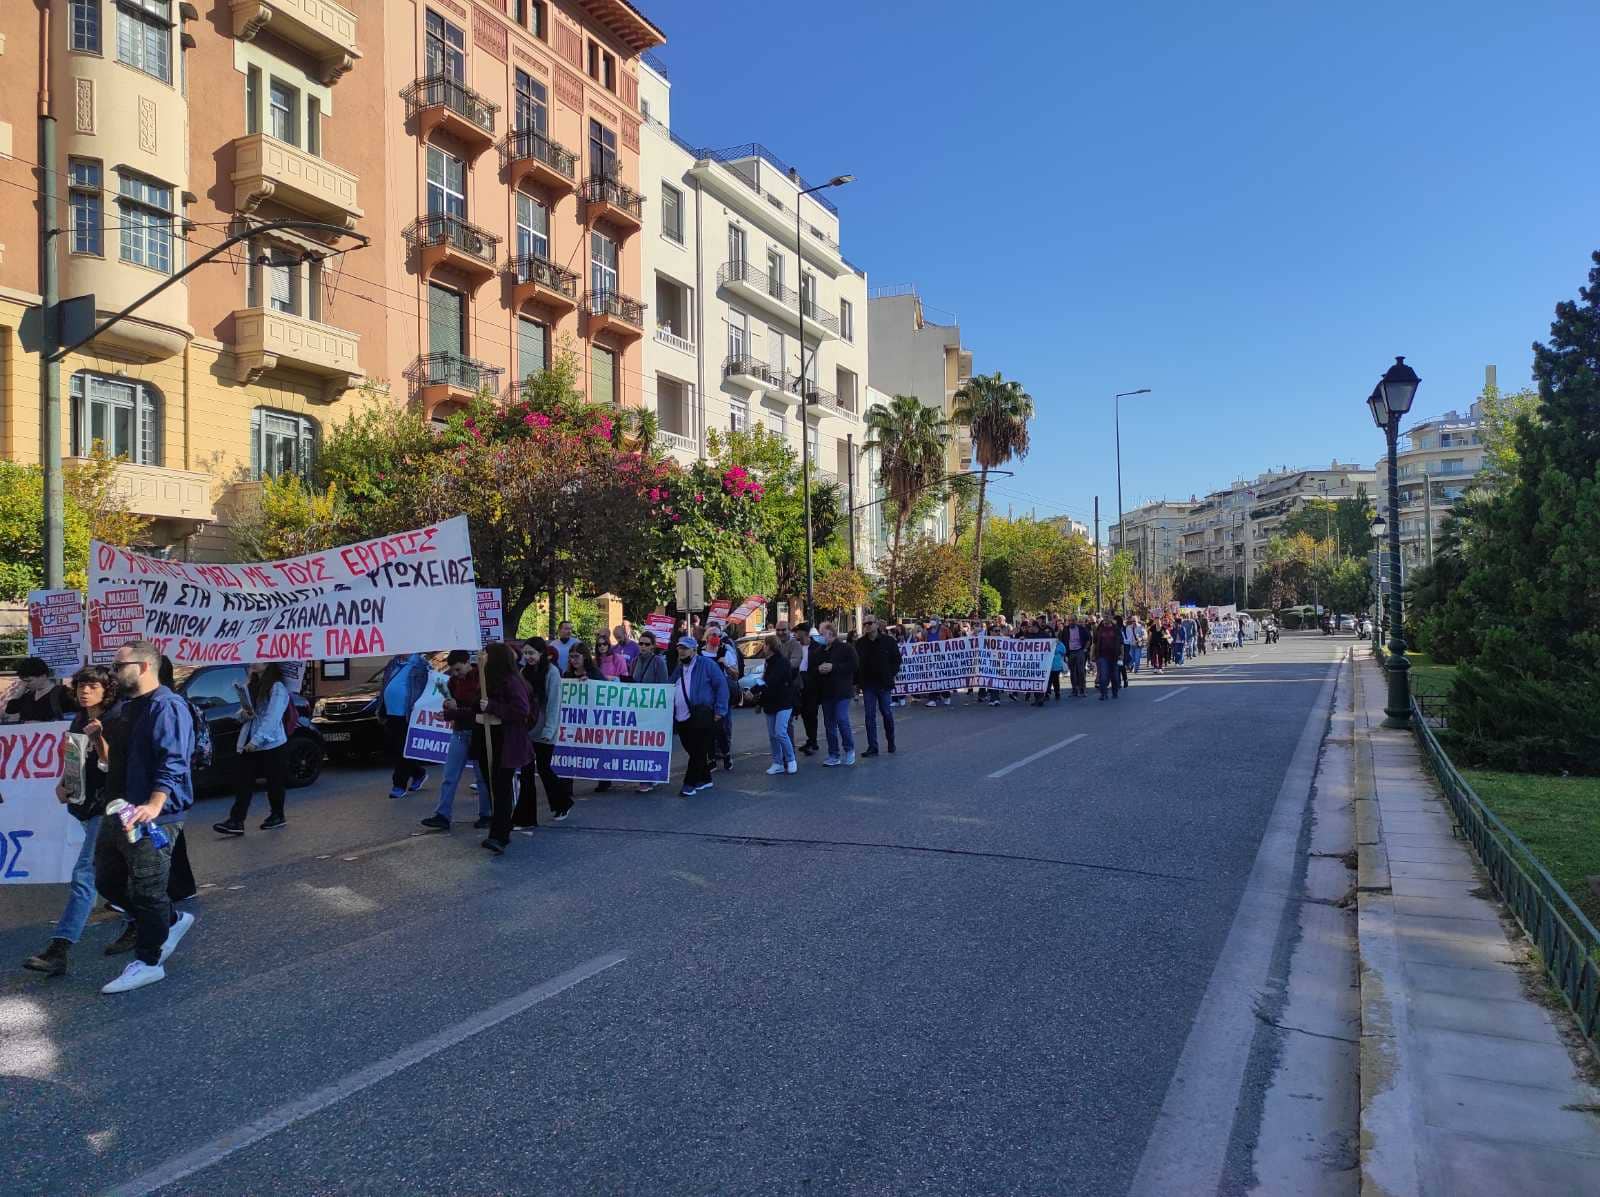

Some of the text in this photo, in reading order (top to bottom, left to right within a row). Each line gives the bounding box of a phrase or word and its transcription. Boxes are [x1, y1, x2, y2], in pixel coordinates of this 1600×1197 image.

[240, 566, 278, 588] ΜΕ
[272, 556, 334, 586] ΤΟΥΣ
[174, 583, 211, 608] ΣΤΗ
[145, 608, 212, 638] ΡΙΚΟΠΩΝ
[214, 619, 244, 639] ΚΑΙ
[274, 596, 386, 630] ΣΚΑΝΔΑΛΩΝ
[256, 632, 313, 659] ΣΔΟΚΕ
[326, 626, 385, 657] ΠΑΔΑ
[944, 640, 966, 652] ΑΠΟ
[983, 639, 1051, 652] ΝΟΣΟΚΟΜΕΙΑ
[595, 685, 668, 709] ΕΡΓΑΣΙΑ
[593, 709, 637, 727] ΥΓΕΙΑ
